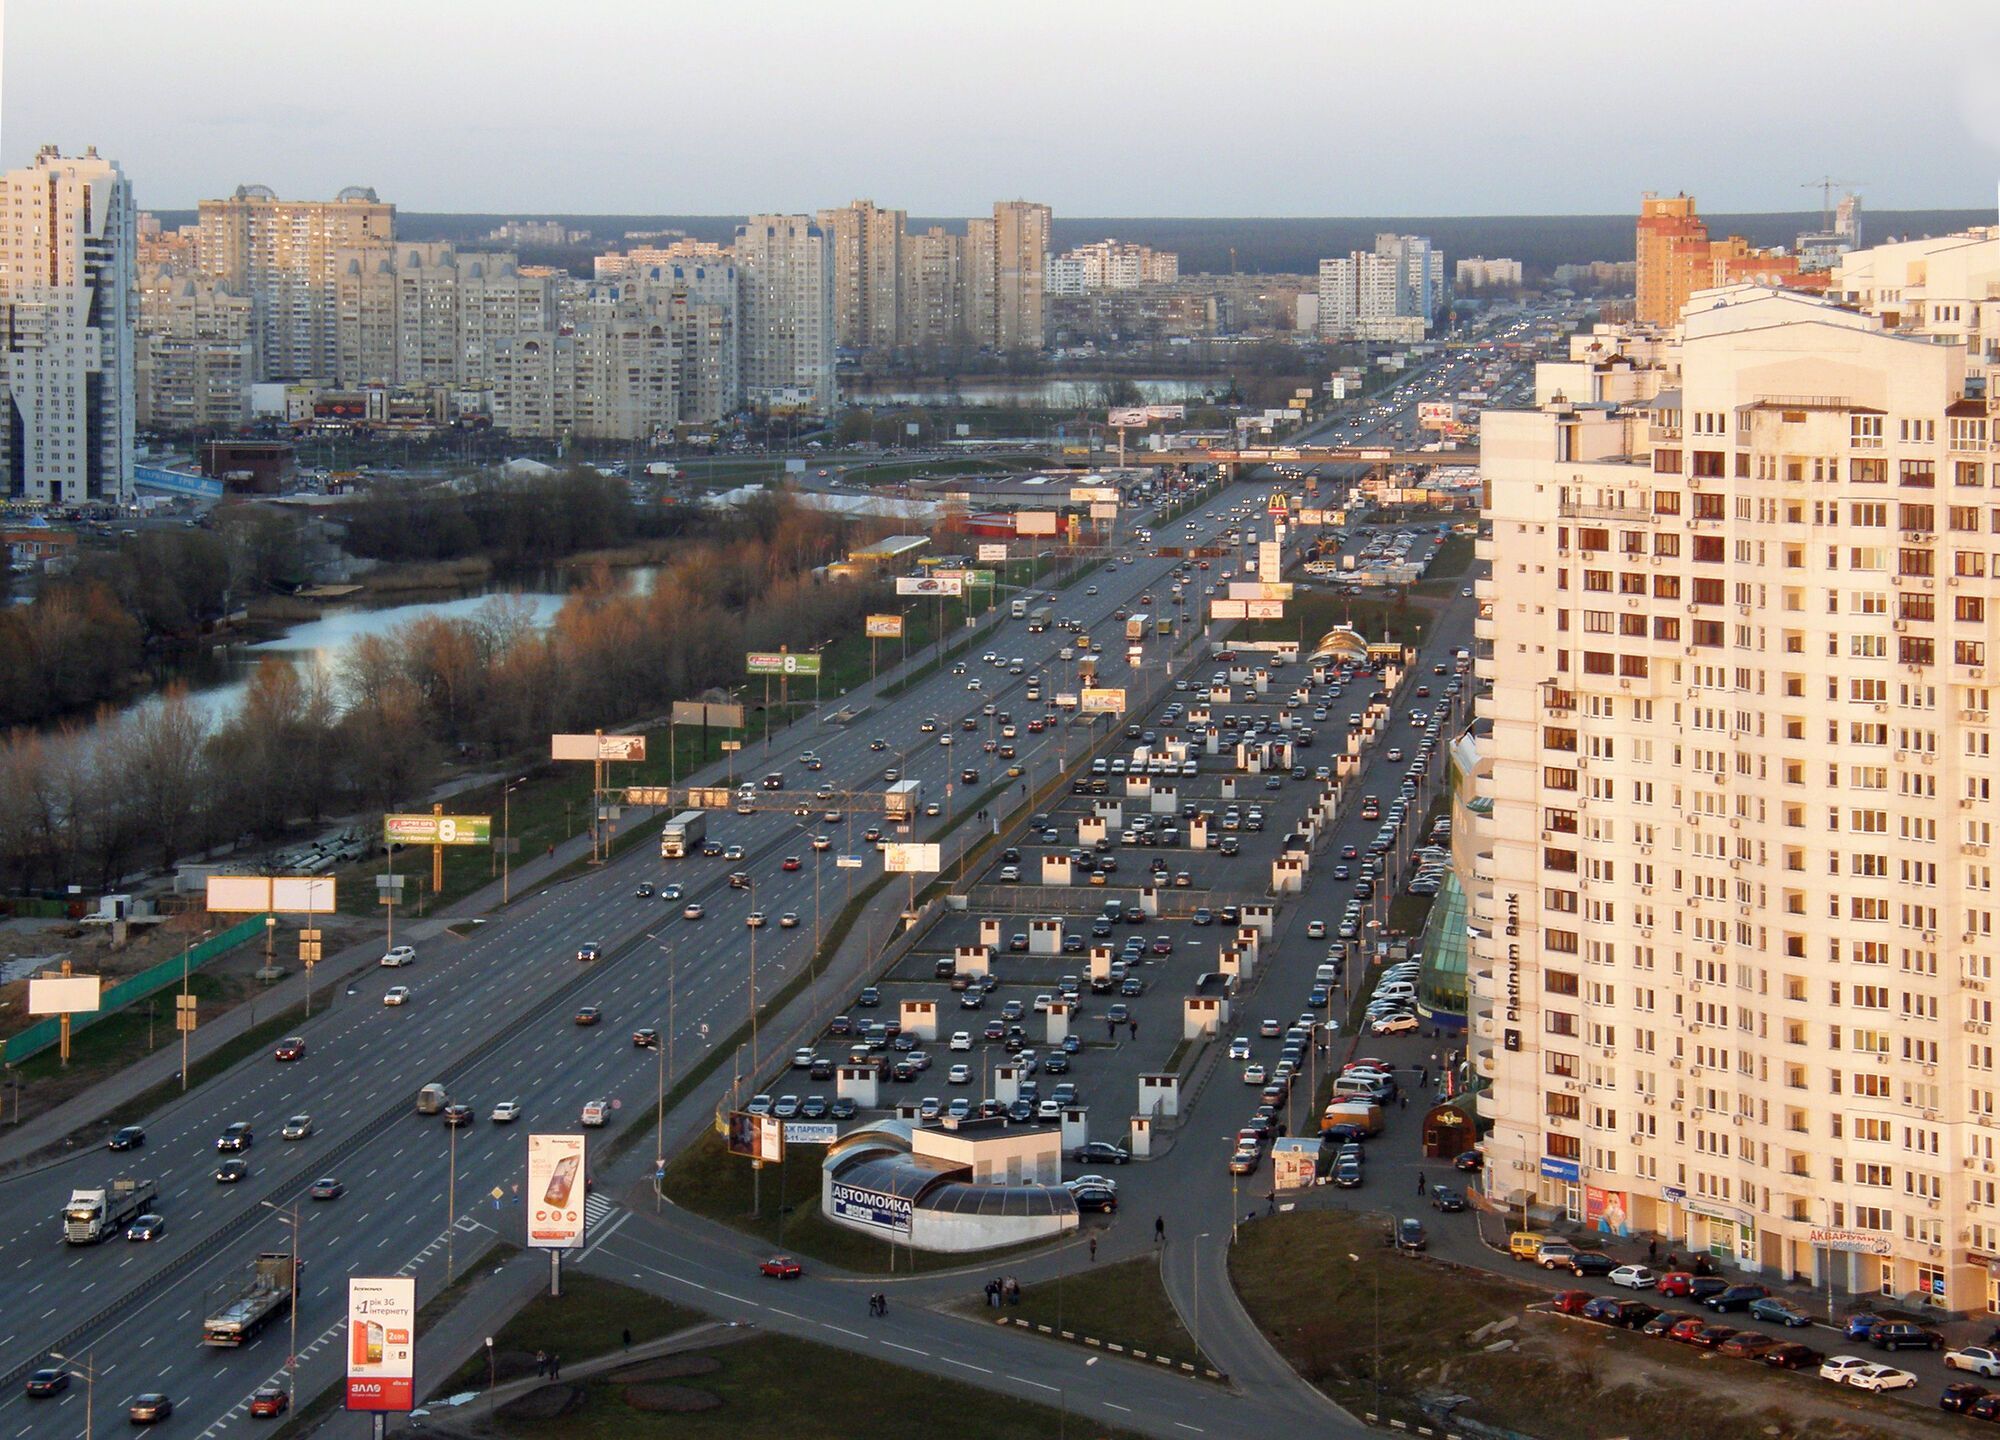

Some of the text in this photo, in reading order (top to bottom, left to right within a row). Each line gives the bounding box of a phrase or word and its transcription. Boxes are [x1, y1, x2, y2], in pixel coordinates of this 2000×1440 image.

[784, 656, 796, 673] 8
[439, 819, 456, 842] 8
[1505, 892, 1520, 1022] Platinum Bank
[833, 1185, 912, 1214] АВТОМОЙКА
[369, 1308, 409, 1316] інтернету
[384, 1298, 395, 1306] 3G
